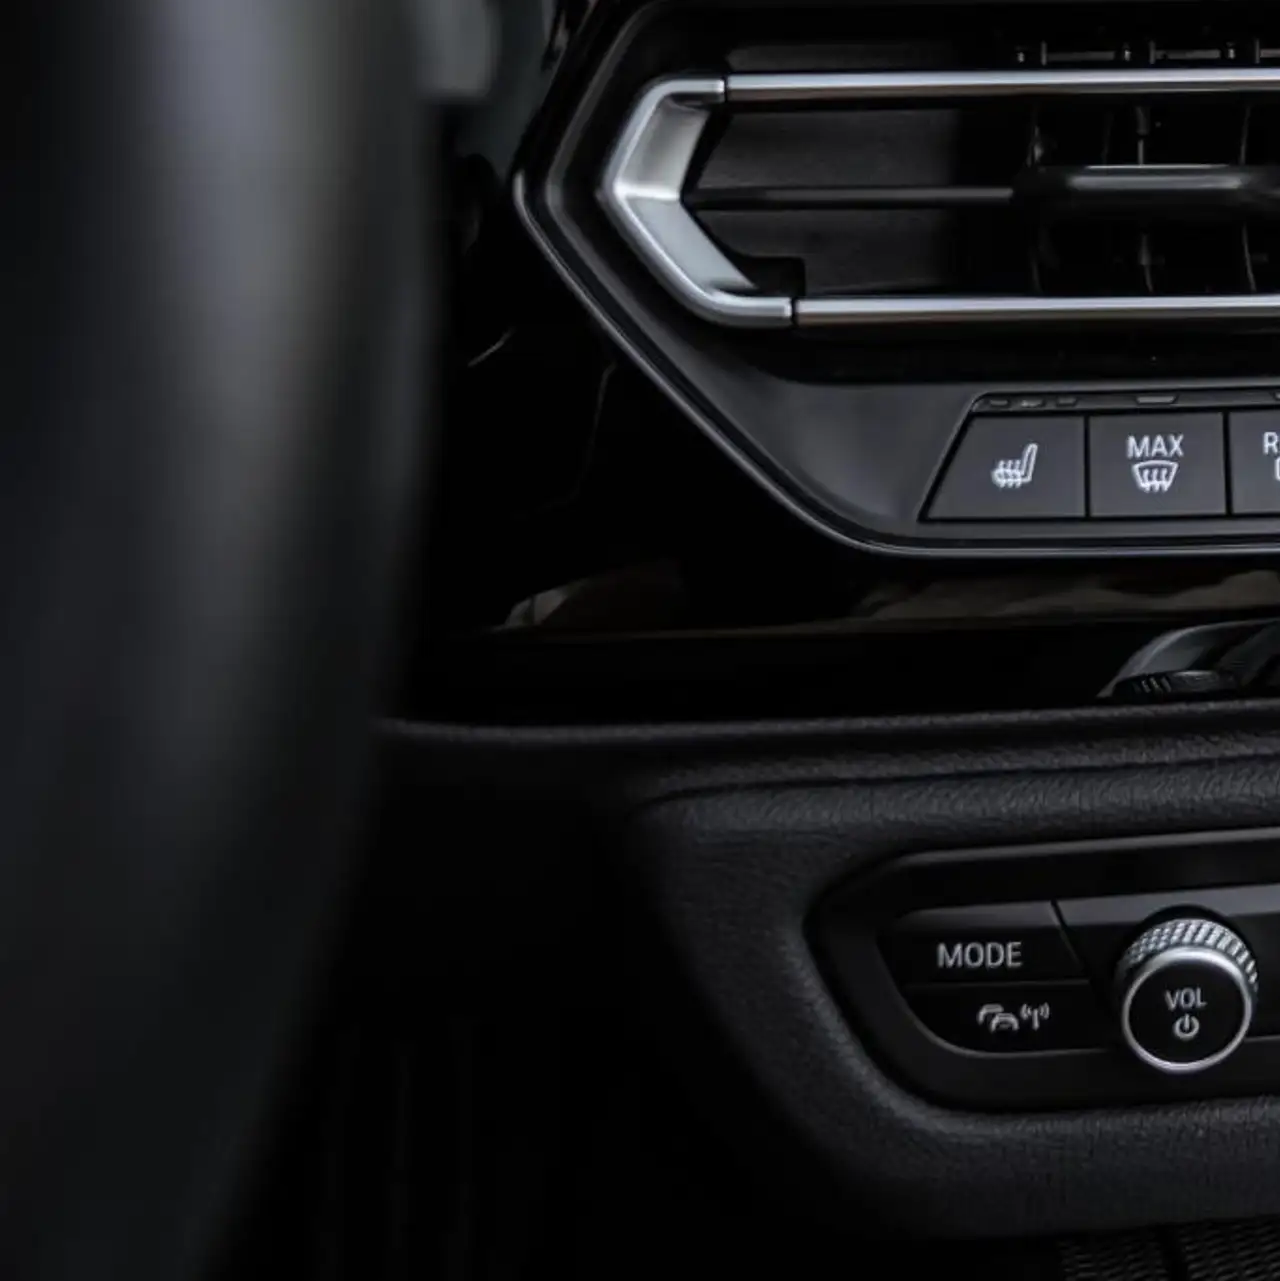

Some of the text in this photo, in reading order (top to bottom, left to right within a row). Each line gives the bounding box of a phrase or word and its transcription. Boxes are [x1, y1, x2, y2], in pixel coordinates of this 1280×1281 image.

[1126, 433, 1185, 459] MAX
[937, 941, 1023, 968] MODE
[1165, 988, 1207, 1012] VOL
